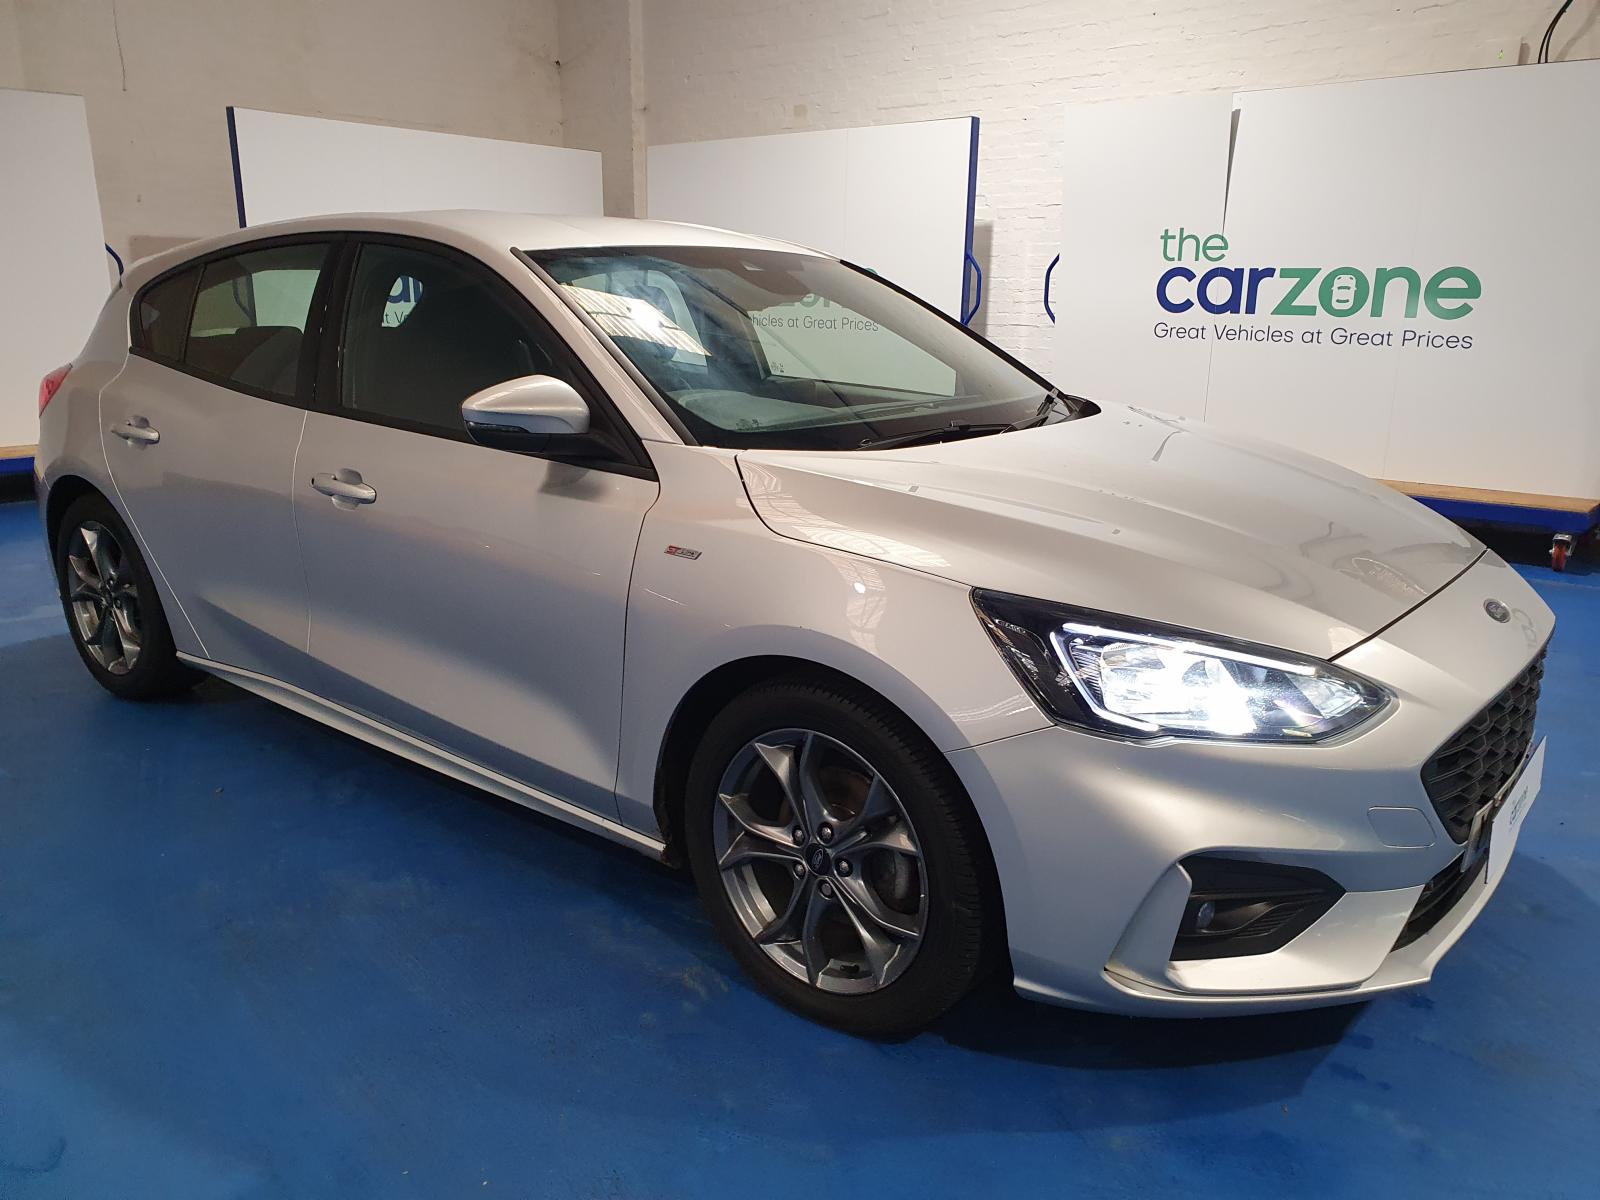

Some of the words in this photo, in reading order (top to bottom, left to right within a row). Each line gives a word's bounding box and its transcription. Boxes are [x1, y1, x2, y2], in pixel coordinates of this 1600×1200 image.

[1160, 227, 1229, 262] the
[1156, 266, 1482, 321] carzone
[751, 313, 784, 328] hicles
[787, 316, 799, 329] at
[803, 315, 838, 330] Great
[841, 316, 879, 332] Prices
[1153, 322, 1207, 340] Great
[1213, 324, 1294, 344] Vehicles
[1301, 326, 1323, 345] at
[1330, 327, 1394, 347] Great
[1401, 330, 1474, 350] Prices
